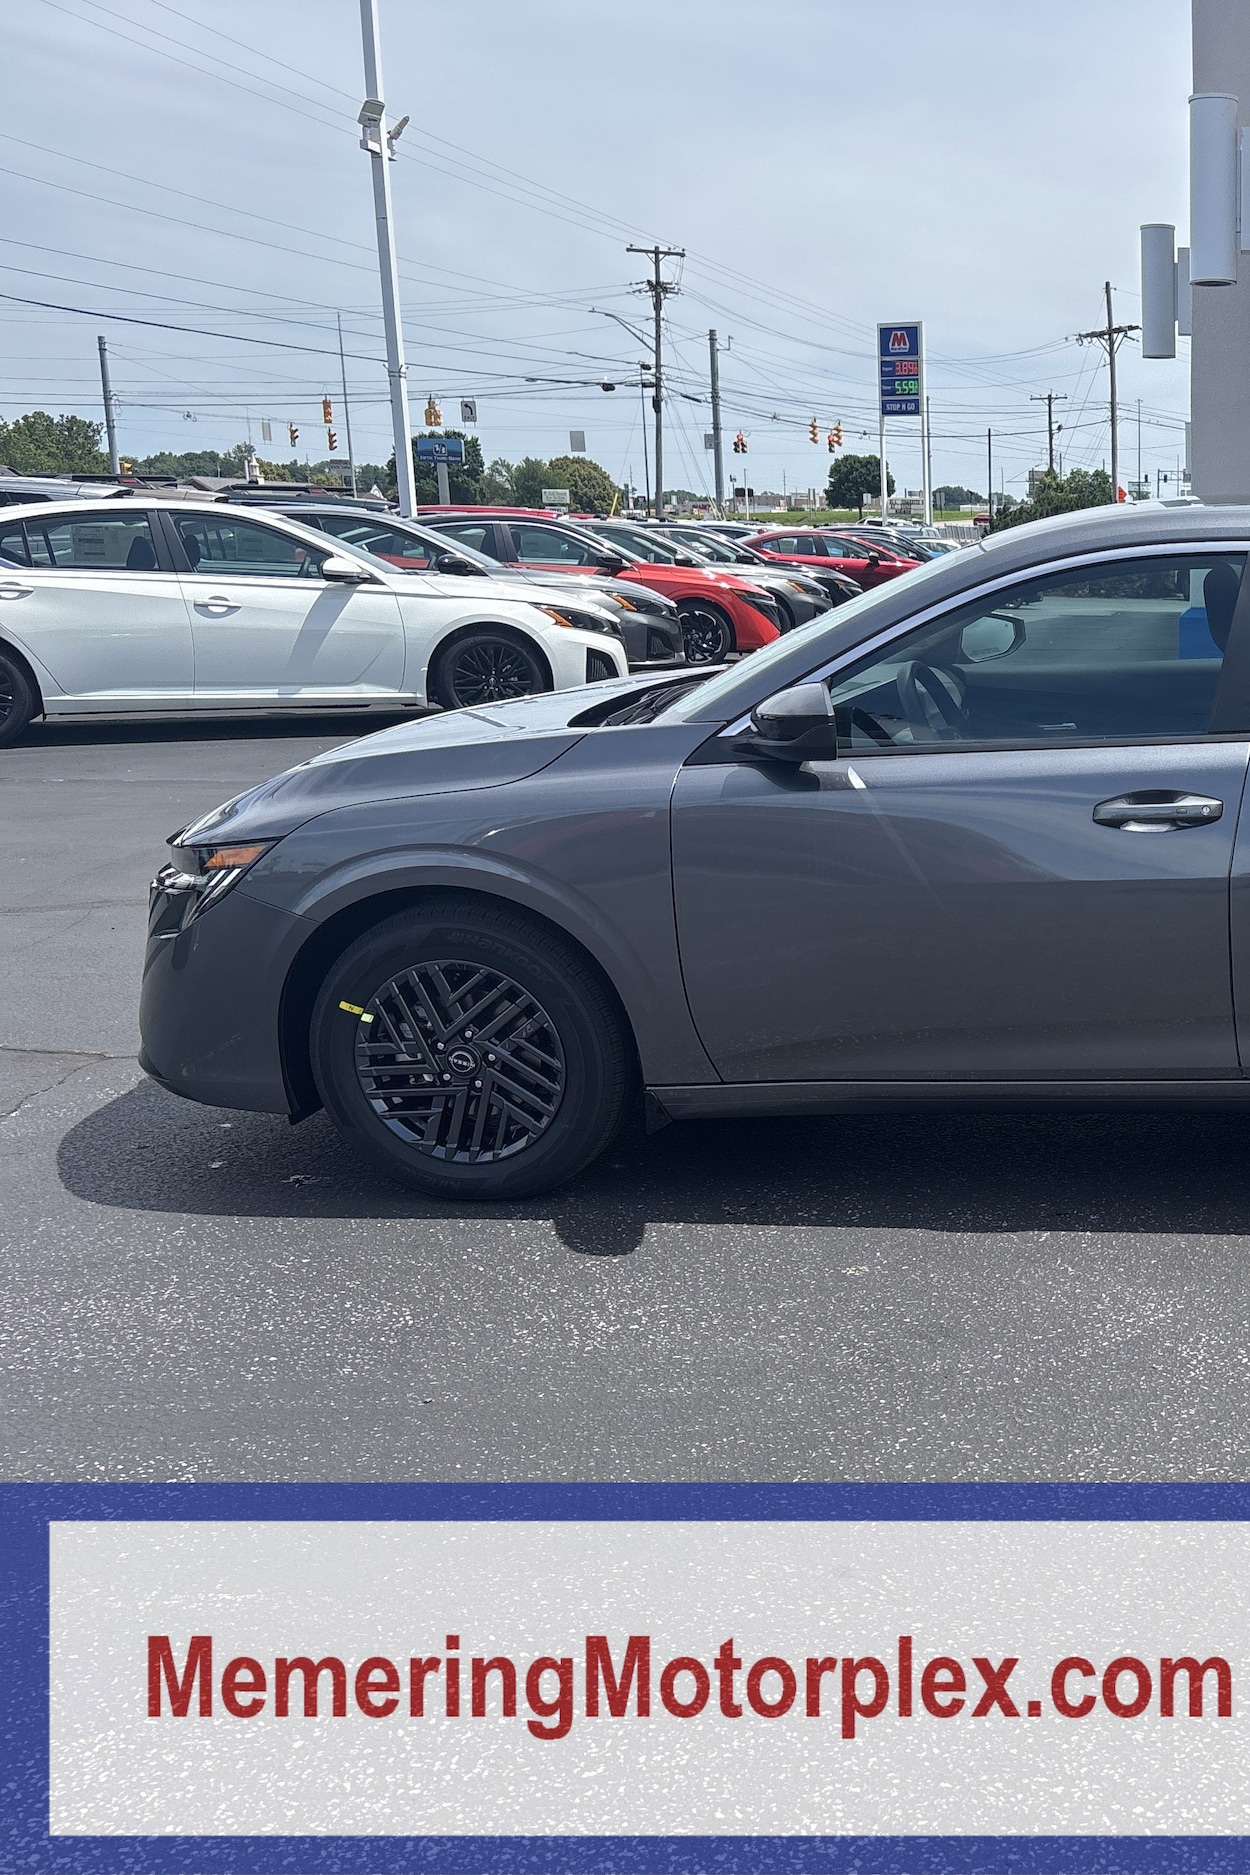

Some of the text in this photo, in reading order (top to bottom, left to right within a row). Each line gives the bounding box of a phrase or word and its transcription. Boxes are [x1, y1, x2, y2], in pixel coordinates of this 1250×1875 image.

[886, 402, 916, 411] STOP N GO
